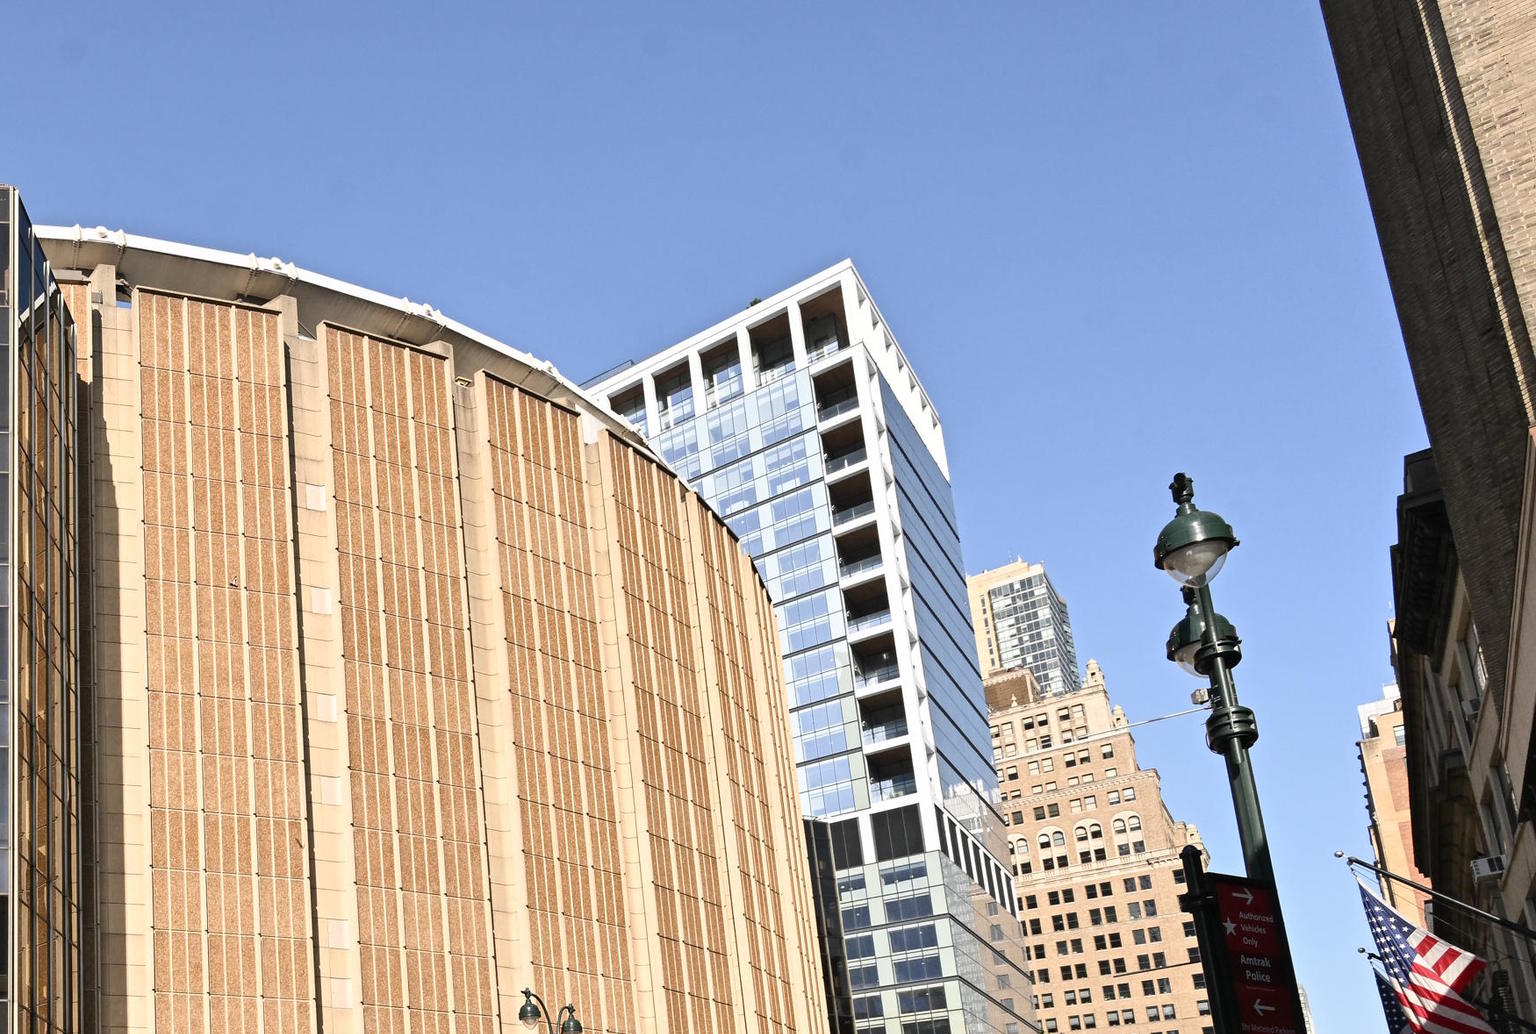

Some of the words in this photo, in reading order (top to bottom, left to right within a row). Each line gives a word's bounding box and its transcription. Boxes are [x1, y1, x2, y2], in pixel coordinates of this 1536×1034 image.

[1239, 912, 1274, 923] Authorized
[1240, 924, 1266, 935] Vehicles
[1242, 936, 1258, 948] Only
[1240, 954, 1272, 967] Amtrak
[1245, 969, 1272, 983] Police
